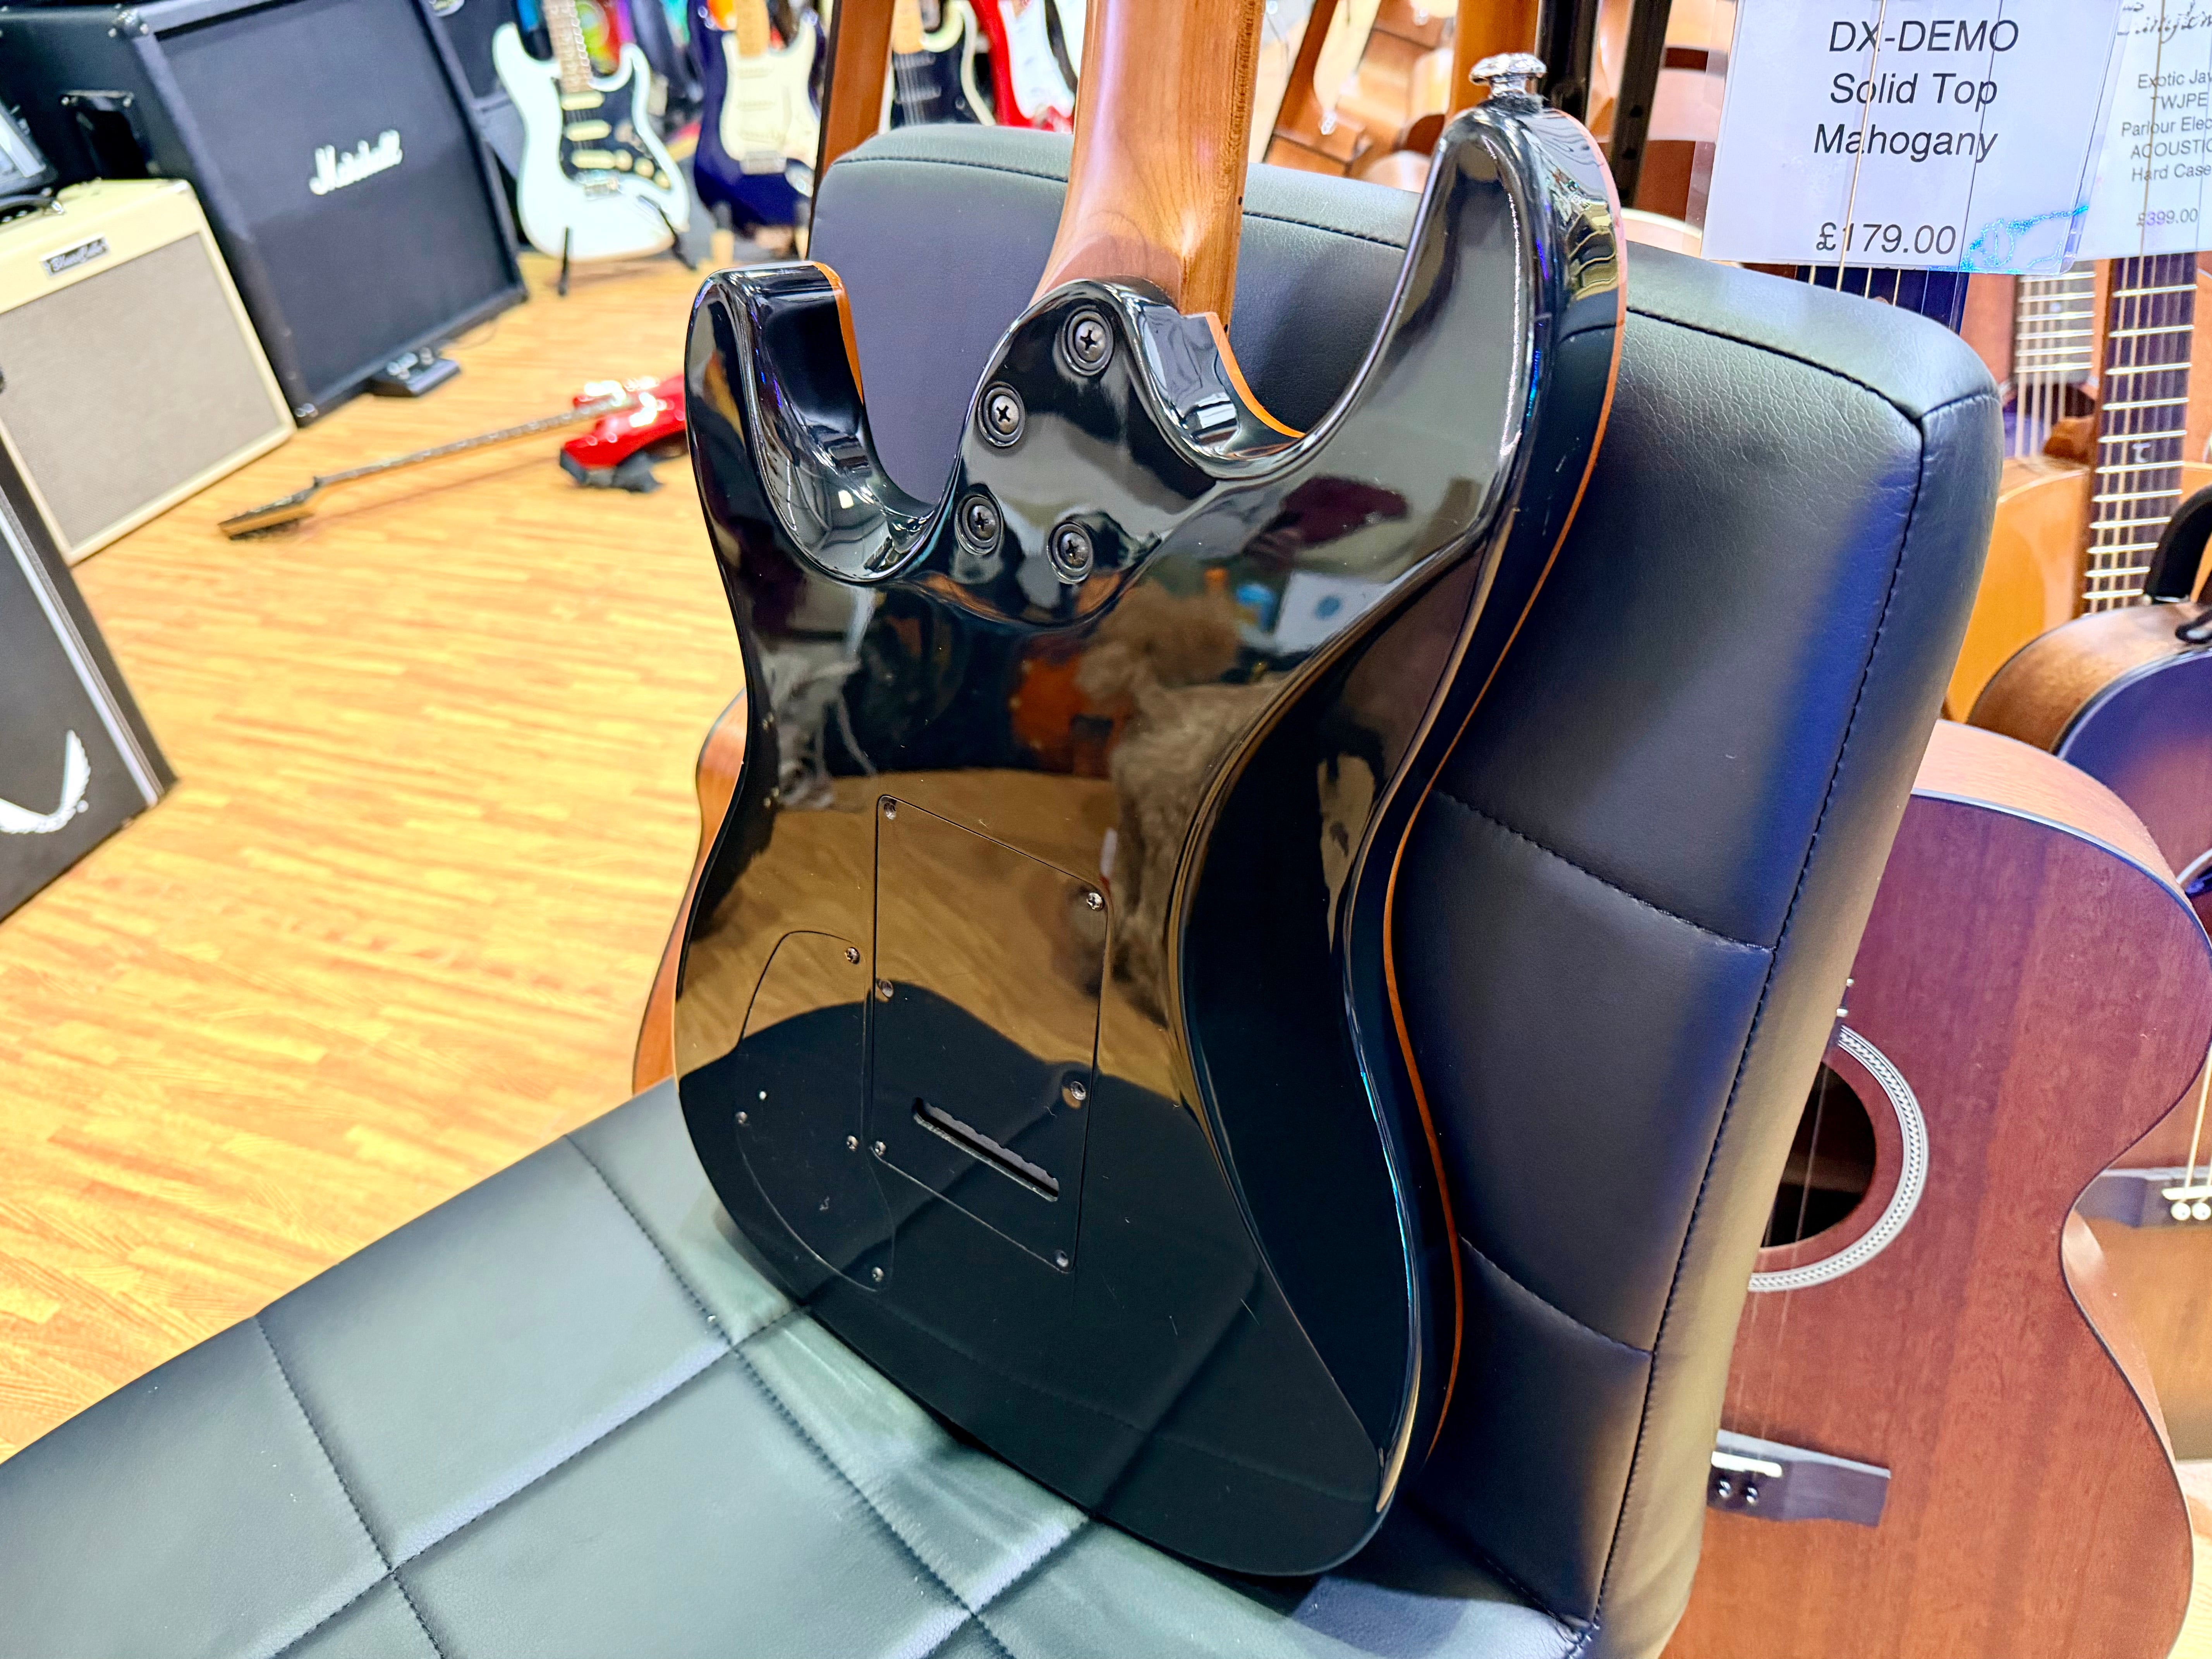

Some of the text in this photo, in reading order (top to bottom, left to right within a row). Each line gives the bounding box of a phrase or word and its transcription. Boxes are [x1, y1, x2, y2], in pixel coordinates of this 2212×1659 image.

[1829, 20, 2019, 52] DX-DEMO
[1830, 72, 1997, 112] Solid Top
[2138, 71, 2185, 89] Exotic
[1814, 124, 1999, 163] Mahogany
[2121, 120, 2176, 137] Parlour
[2131, 163, 2212, 182] Hard Case
[1815, 222, 1956, 254] £179.00
